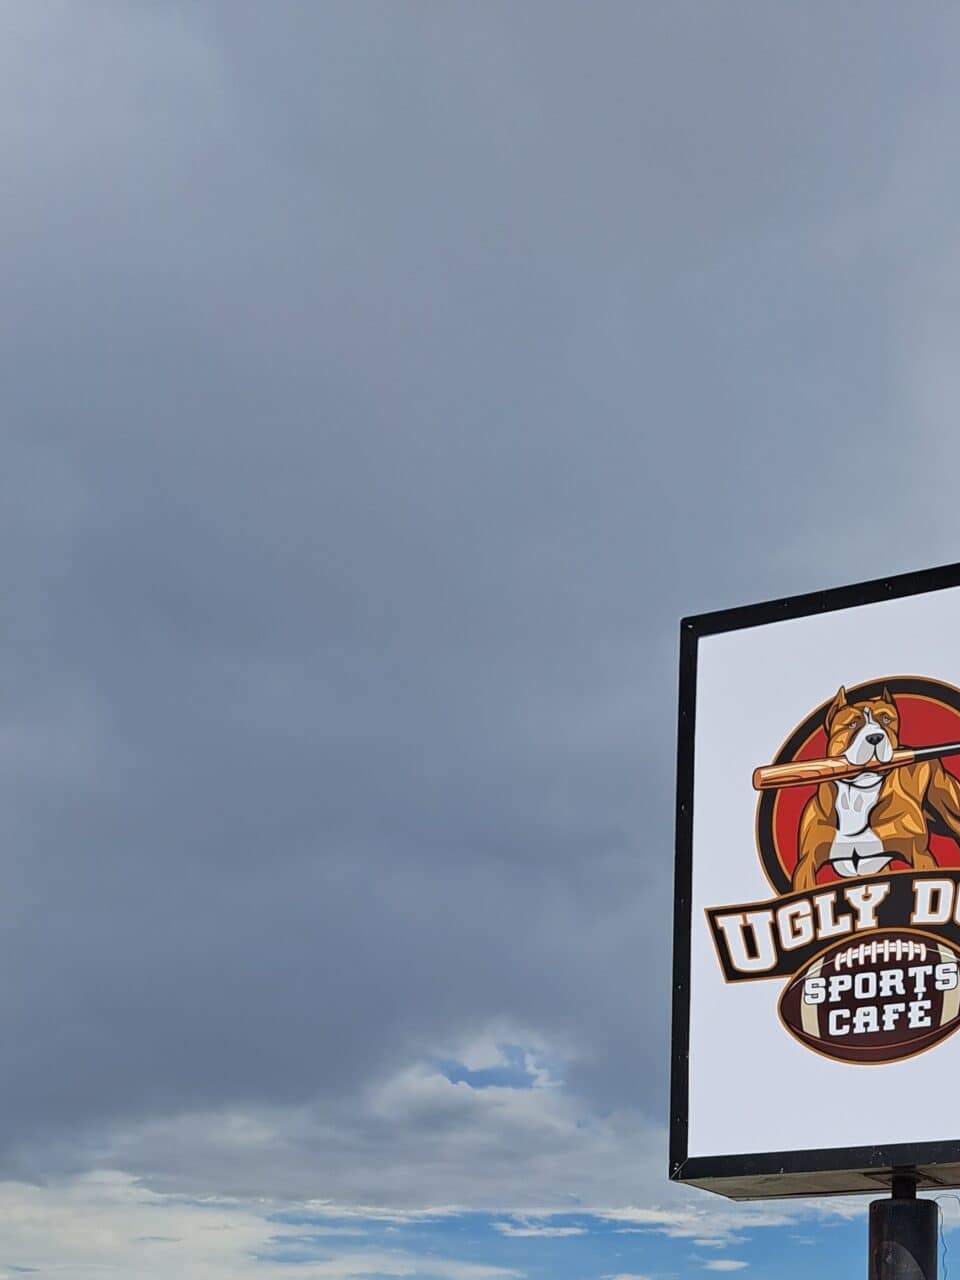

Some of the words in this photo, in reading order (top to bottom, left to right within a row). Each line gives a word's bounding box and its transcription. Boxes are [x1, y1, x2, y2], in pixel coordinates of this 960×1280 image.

[715, 882, 890, 973] UGLY
[804, 962, 958, 1005] SPORTS
[828, 993, 932, 1037] CAFÉ
